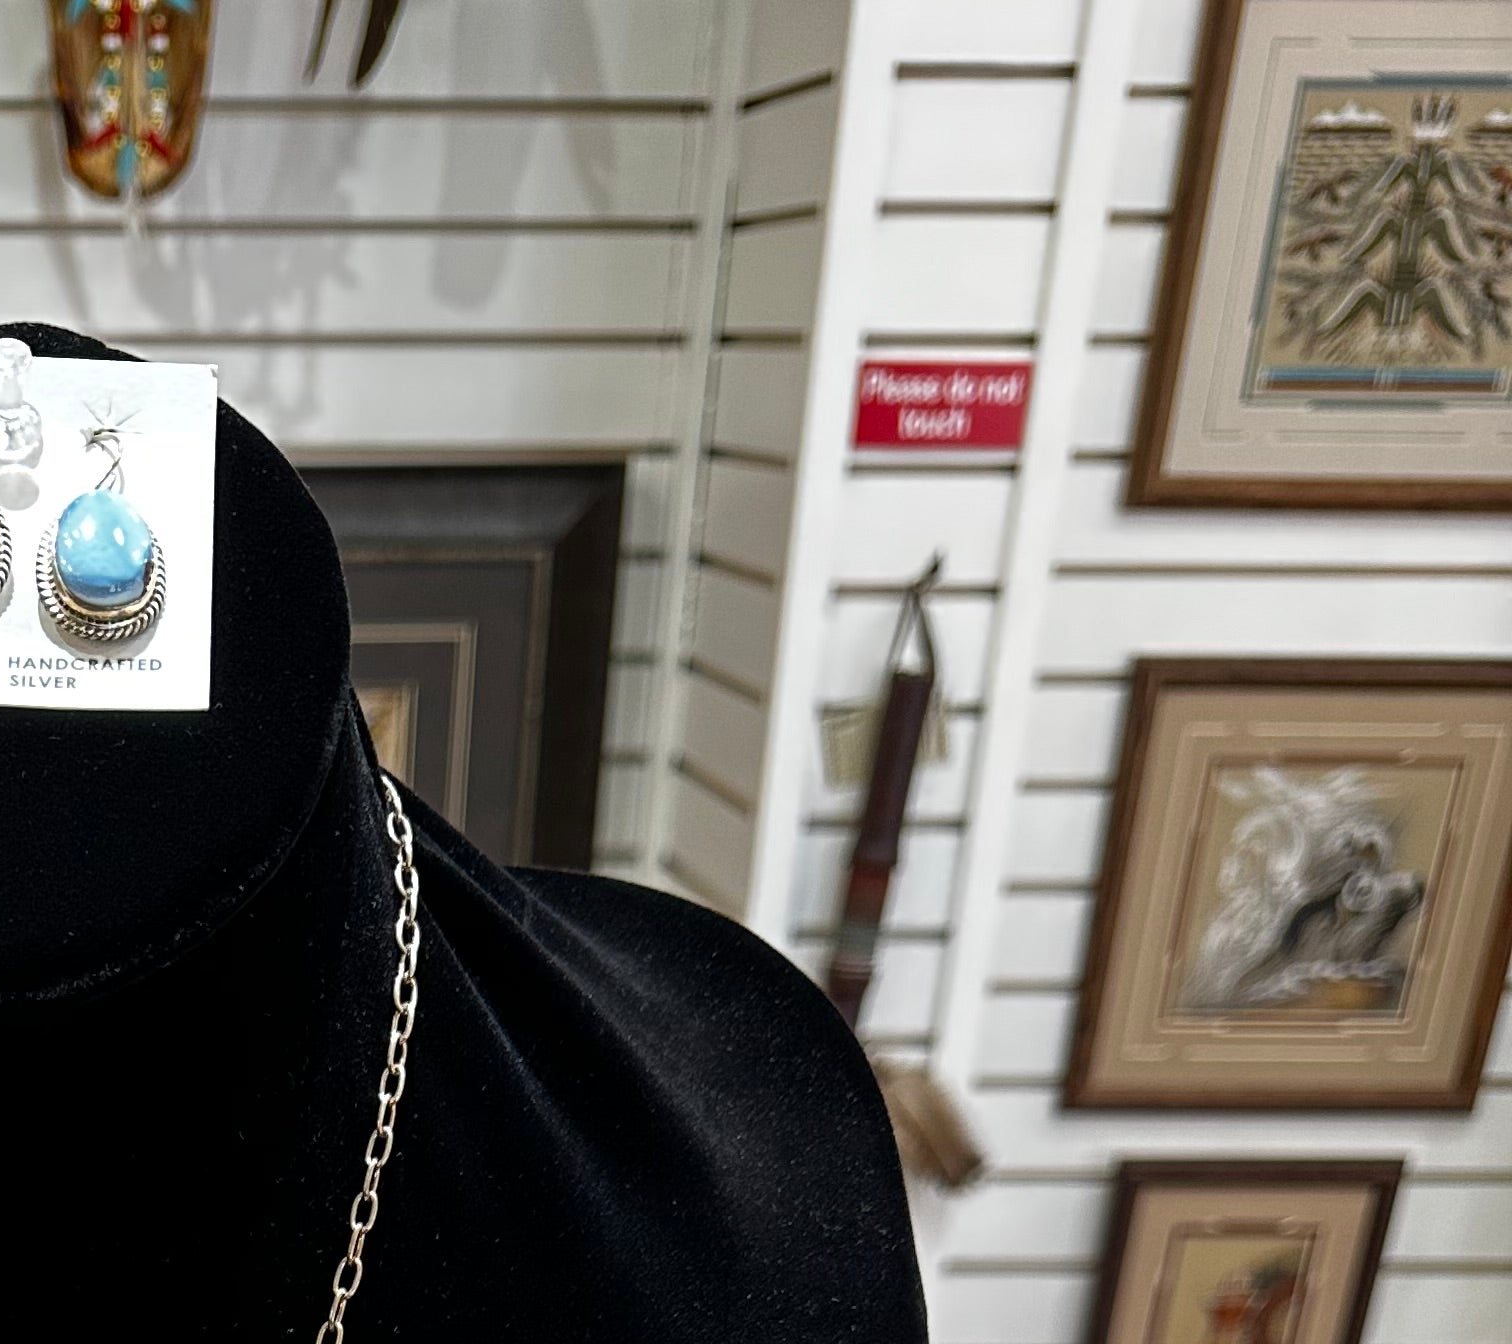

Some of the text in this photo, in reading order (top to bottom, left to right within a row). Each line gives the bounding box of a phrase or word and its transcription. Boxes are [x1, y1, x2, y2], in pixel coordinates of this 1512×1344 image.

[863, 368, 1026, 405] Please do not
[899, 405, 971, 439] touch
[8, 656, 162, 671] HANDCRAFTED
[9, 674, 76, 689] SILVER
